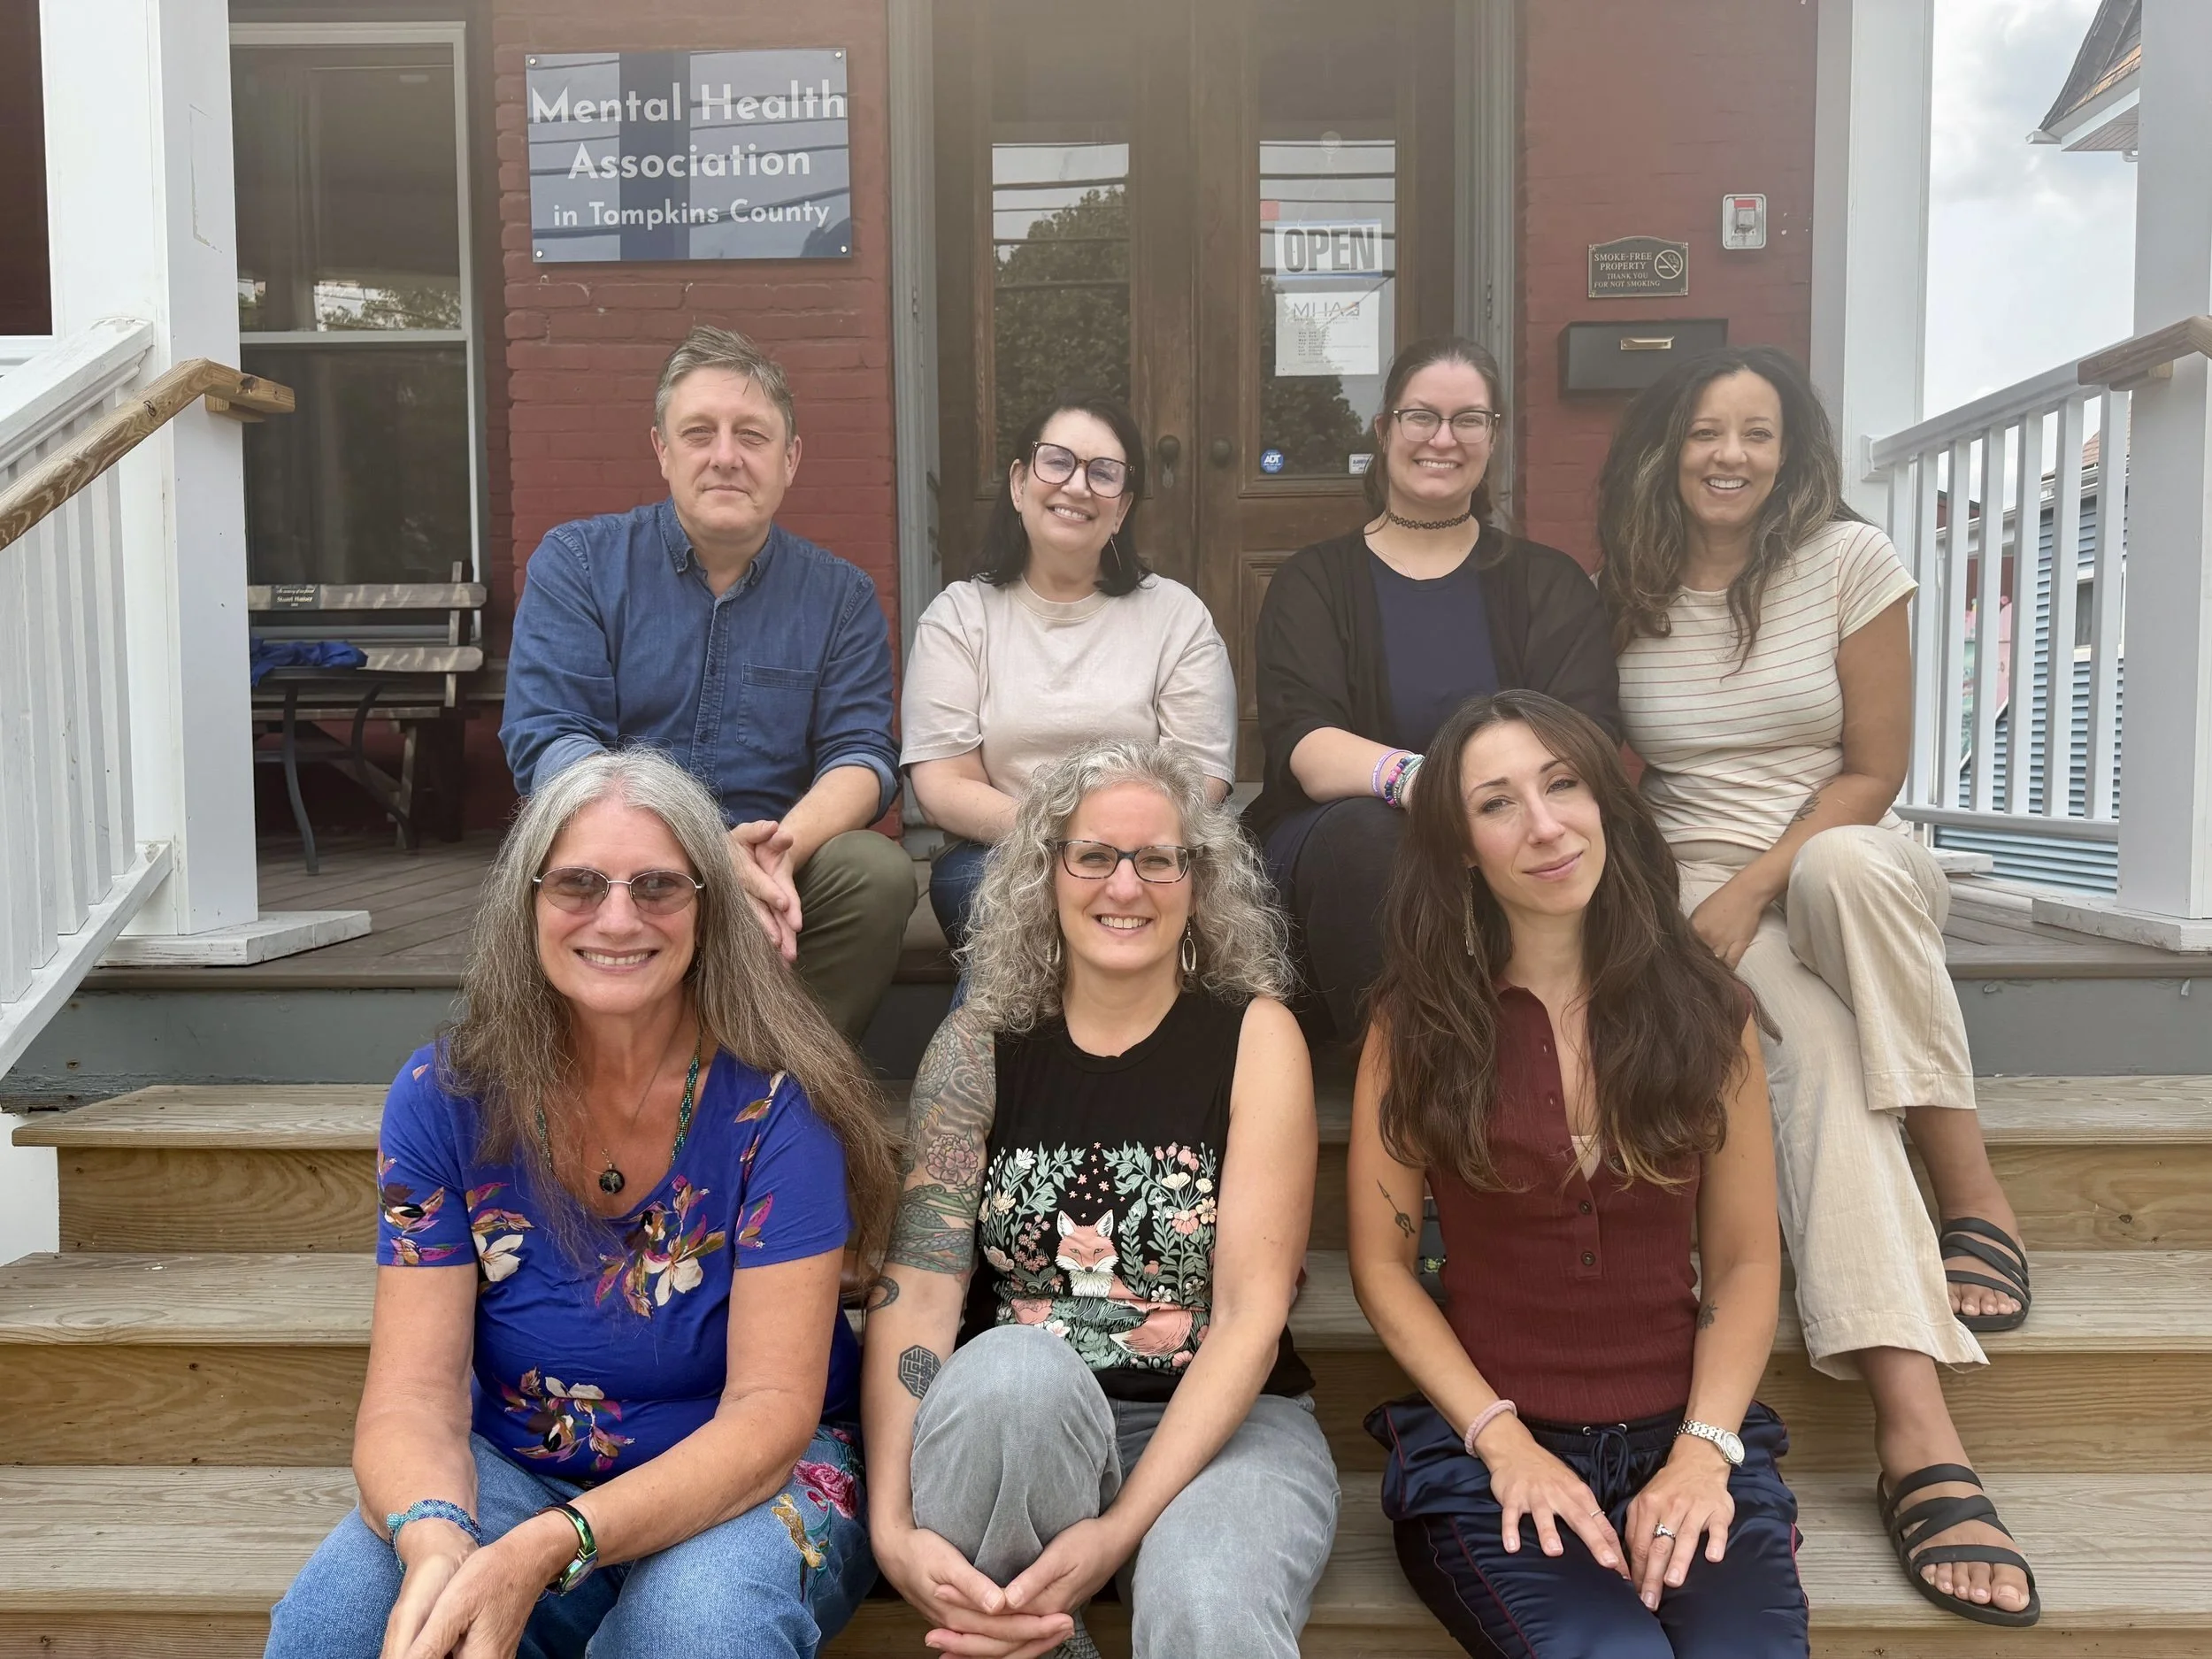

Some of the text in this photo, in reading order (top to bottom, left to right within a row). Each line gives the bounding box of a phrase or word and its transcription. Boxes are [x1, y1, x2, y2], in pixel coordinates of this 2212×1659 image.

[532, 79, 845, 124] Mental Health
[568, 142, 810, 180] Association
[554, 198, 831, 231] in Tompkins County
[1285, 227, 1375, 273] OPEN
[1594, 252, 1652, 262] SMOKE-FREE
[1600, 262, 1646, 271] PROPERTY
[1264, 455, 1281, 464] ADT
